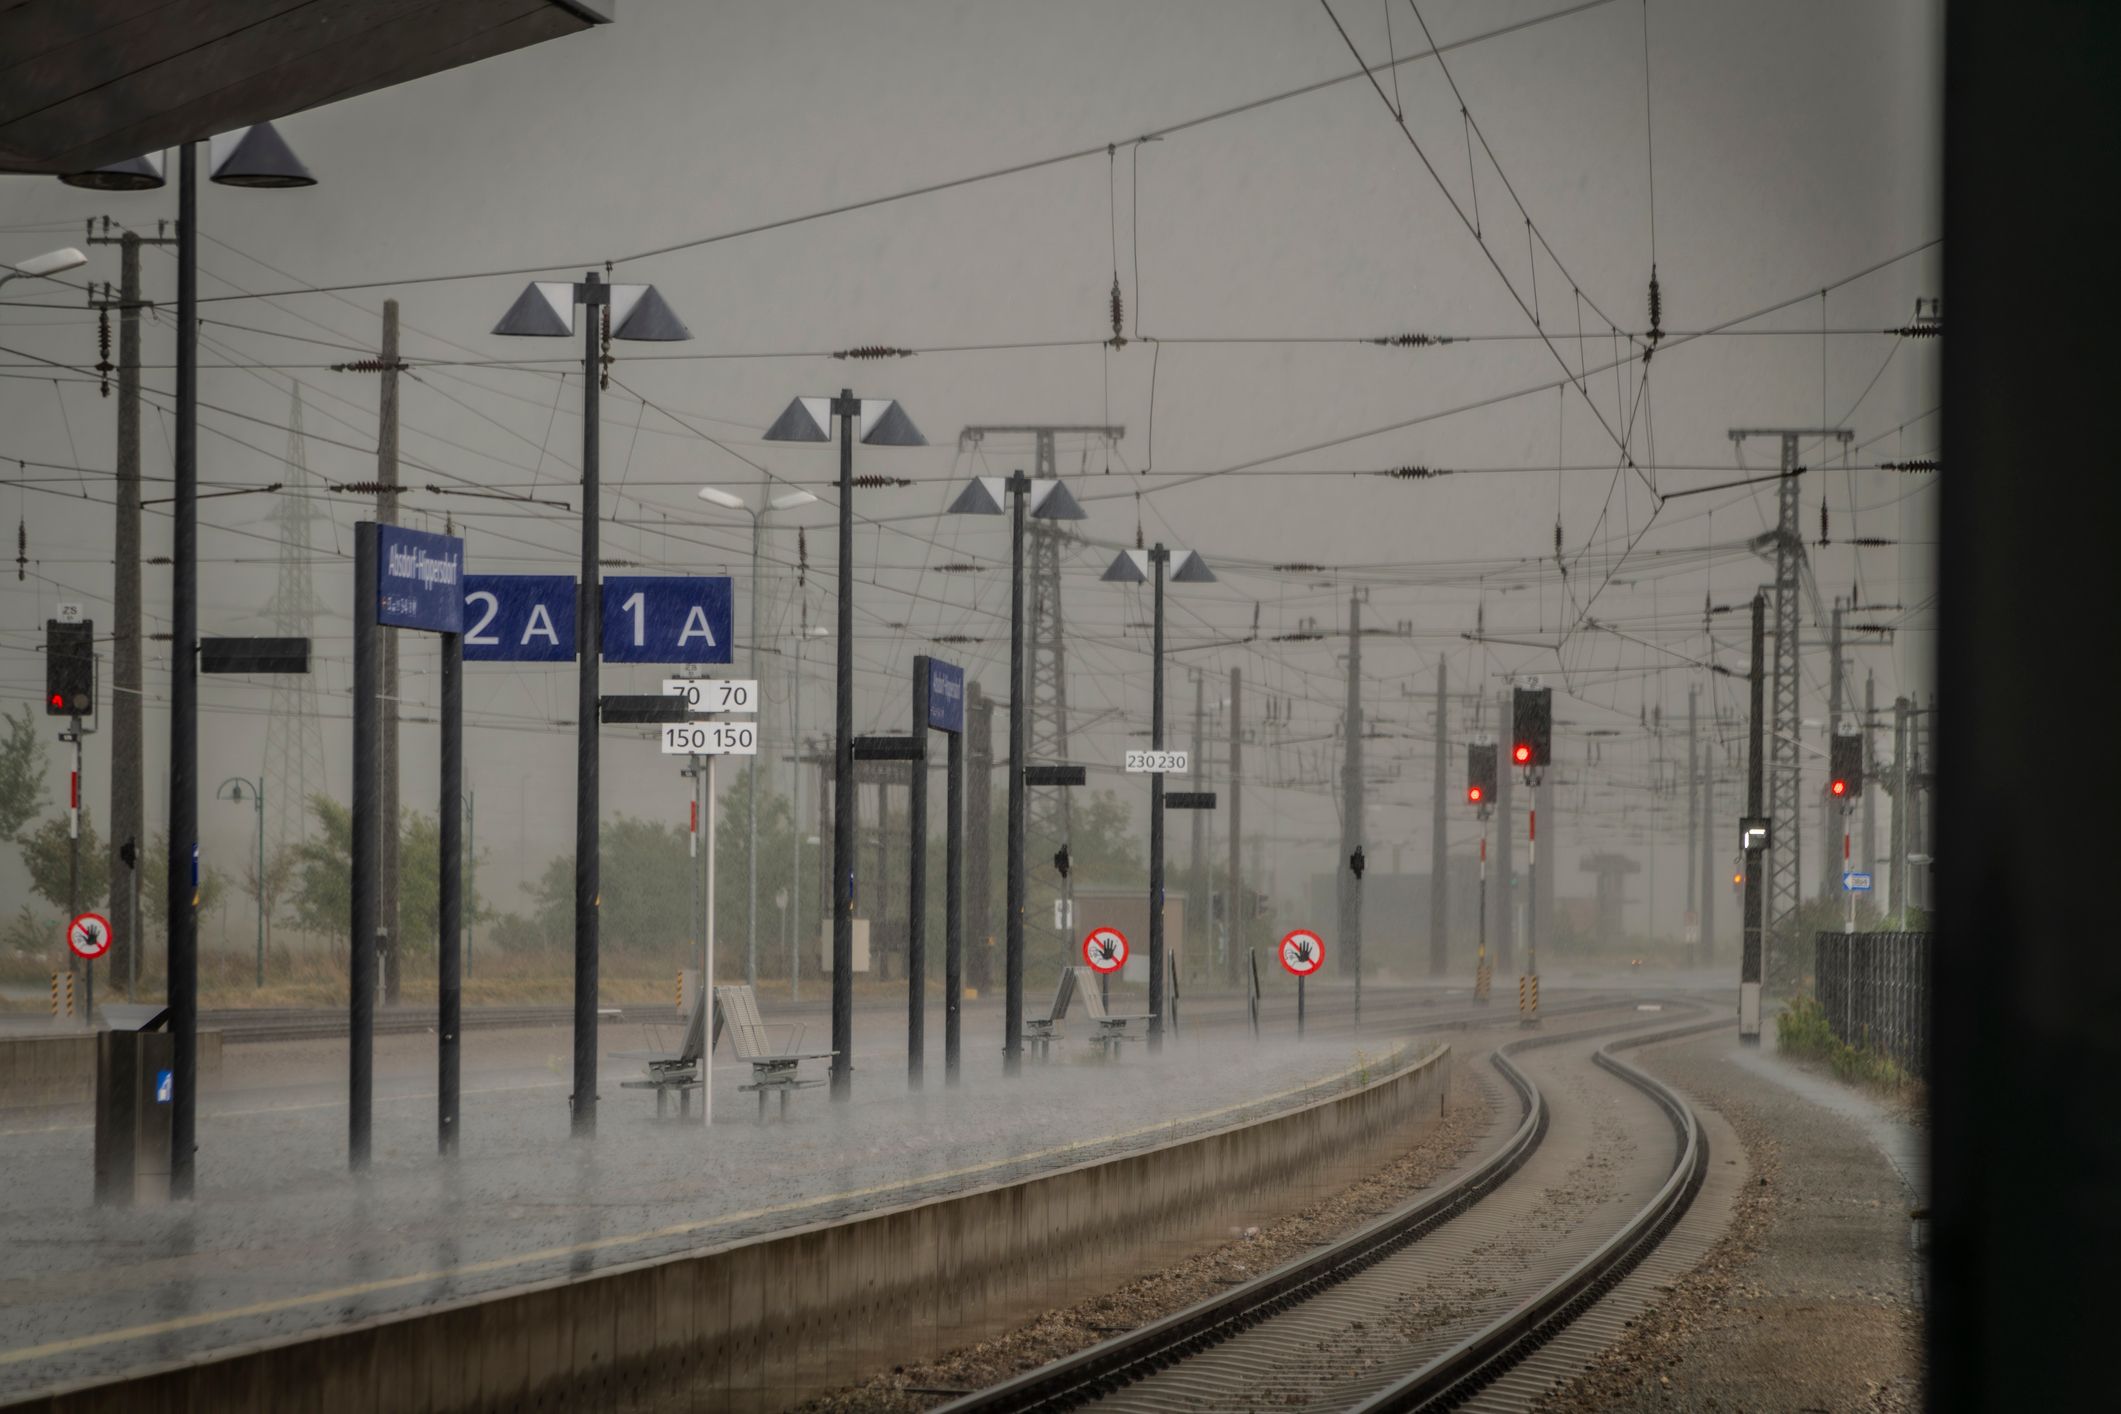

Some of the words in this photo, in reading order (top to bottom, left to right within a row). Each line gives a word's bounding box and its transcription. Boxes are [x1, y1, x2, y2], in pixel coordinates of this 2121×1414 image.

[464, 591, 499, 645] 2
[520, 604, 560, 645] A
[622, 592, 645, 646] 1
[677, 606, 717, 647] A
[719, 687, 747, 706] 70
[666, 729, 706, 749] 150
[713, 729, 753, 748] 150
[1128, 755, 1156, 769] 230
[1158, 756, 1186, 769] 230
